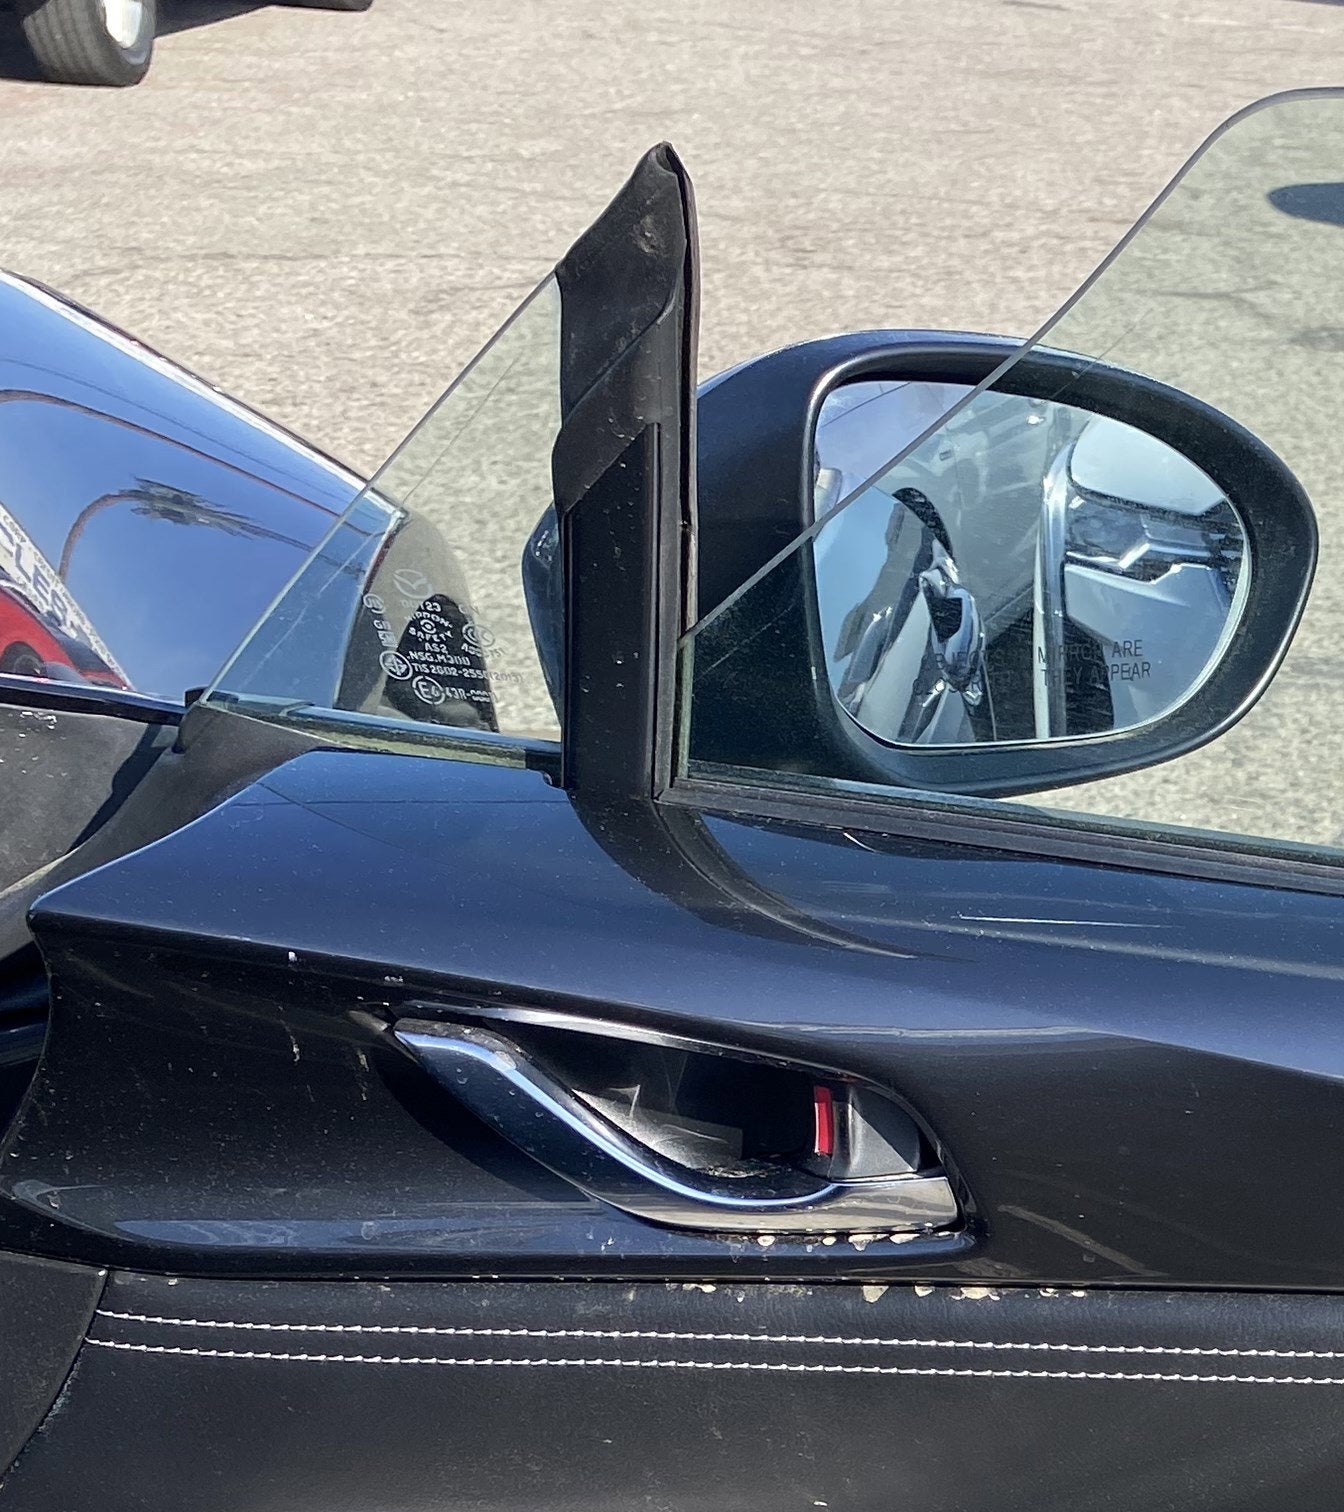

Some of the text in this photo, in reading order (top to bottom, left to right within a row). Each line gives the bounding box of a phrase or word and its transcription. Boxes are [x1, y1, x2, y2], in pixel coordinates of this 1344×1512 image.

[424, 642, 448, 654] AS2
[1111, 639, 1144, 658] ARE
[1090, 661, 1152, 684] APPEAR
